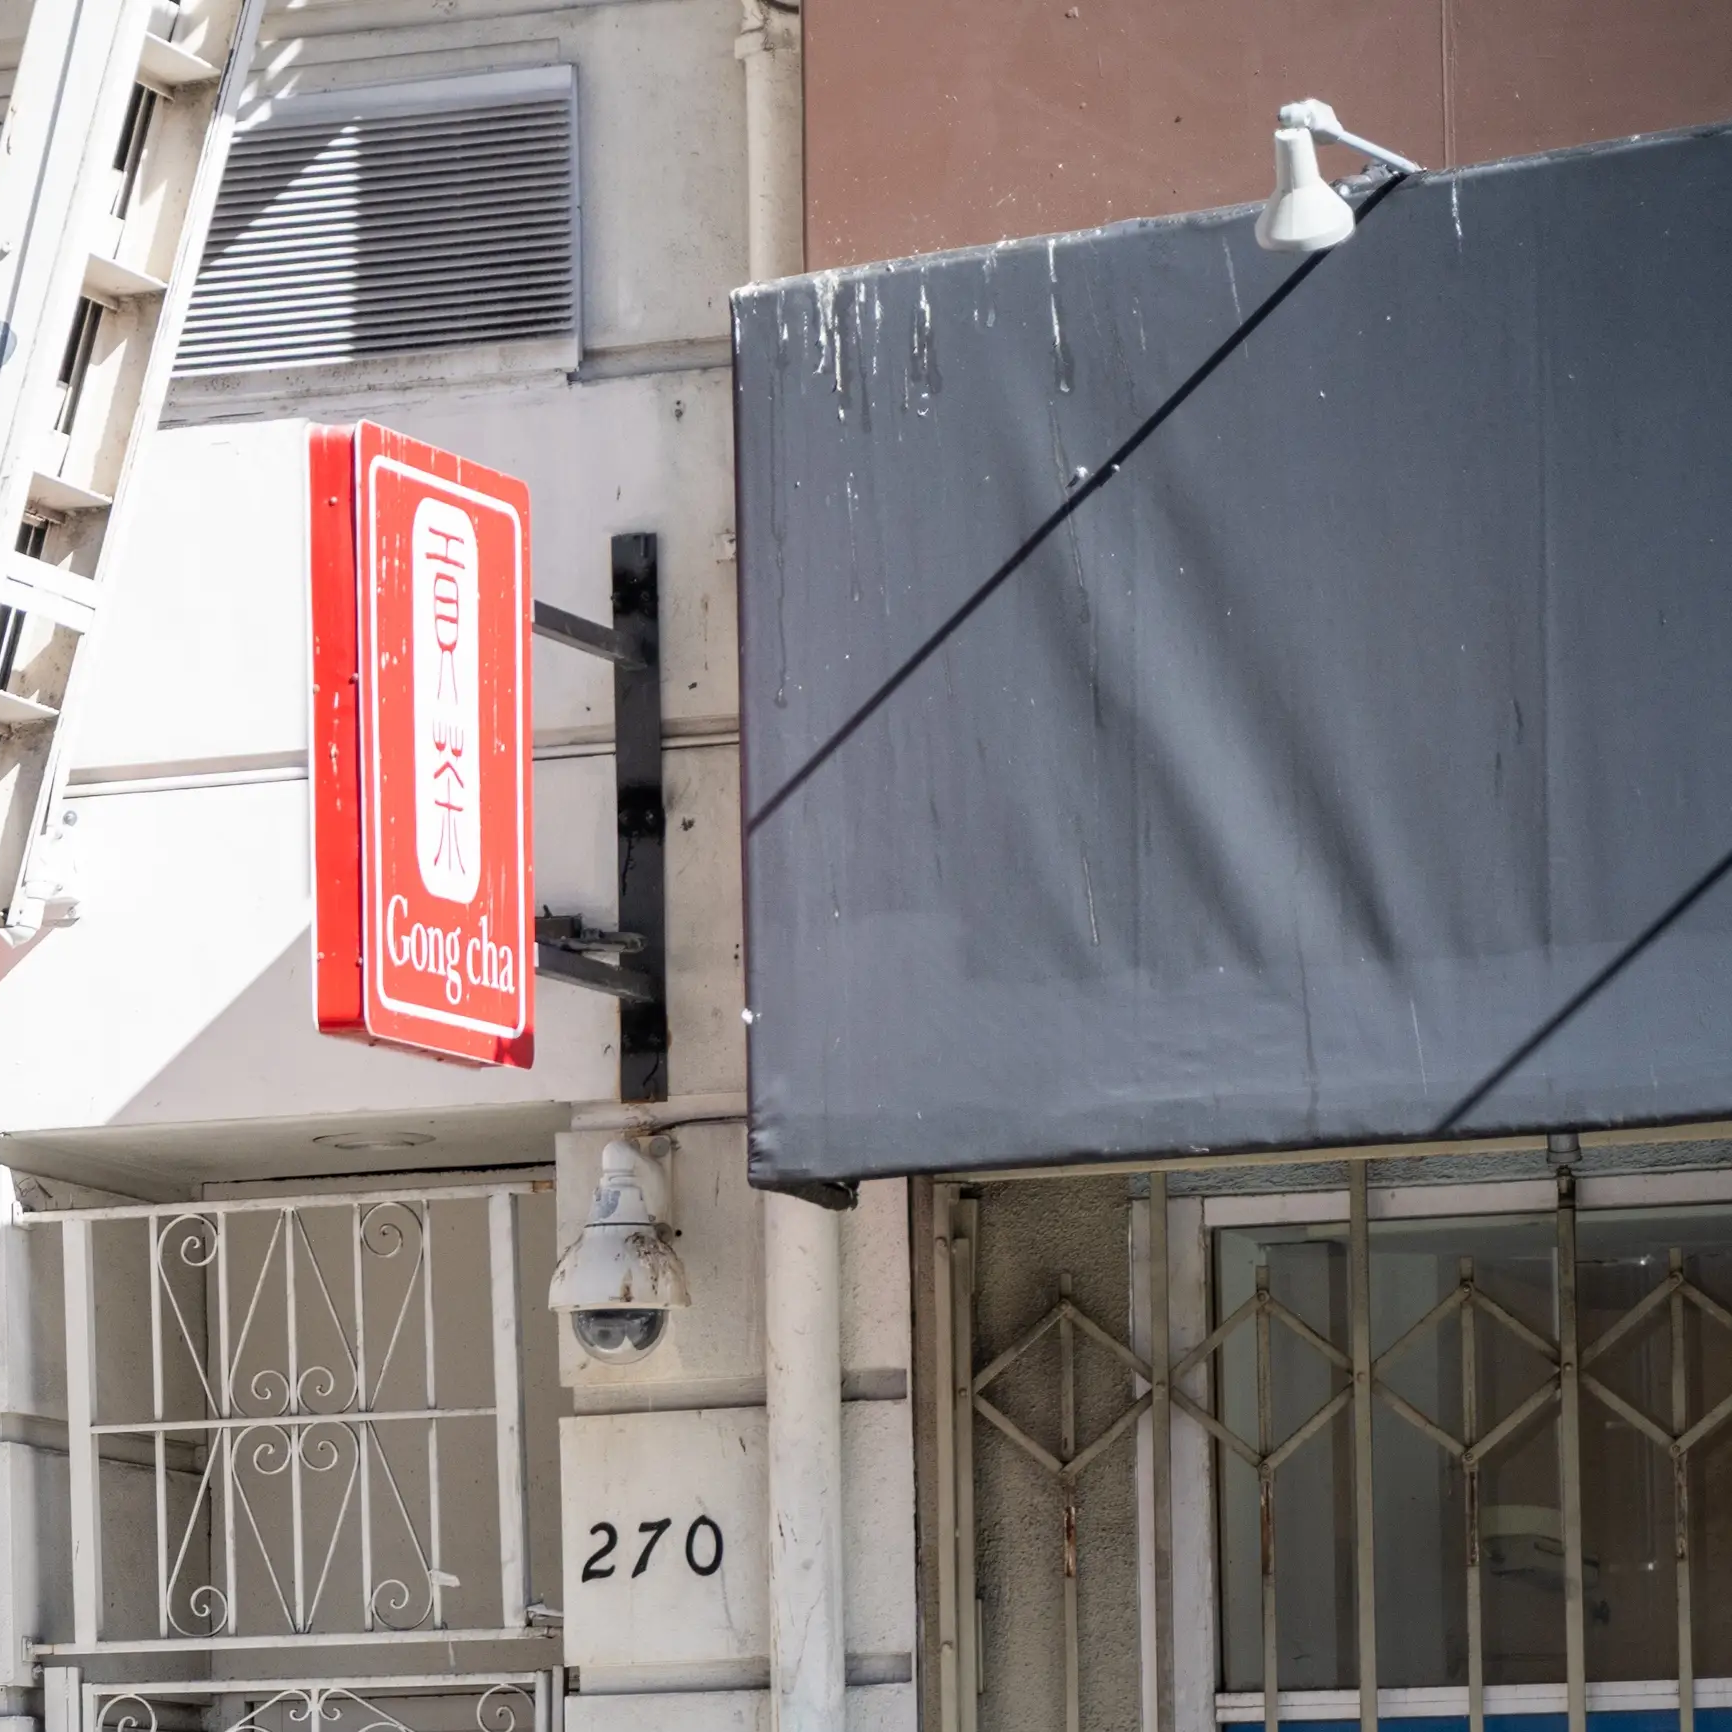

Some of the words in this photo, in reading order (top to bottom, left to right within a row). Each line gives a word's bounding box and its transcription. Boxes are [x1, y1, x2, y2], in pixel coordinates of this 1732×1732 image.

[386, 893, 462, 1005] Gong
[466, 906, 516, 995] cha
[581, 1514, 724, 1583] 270
